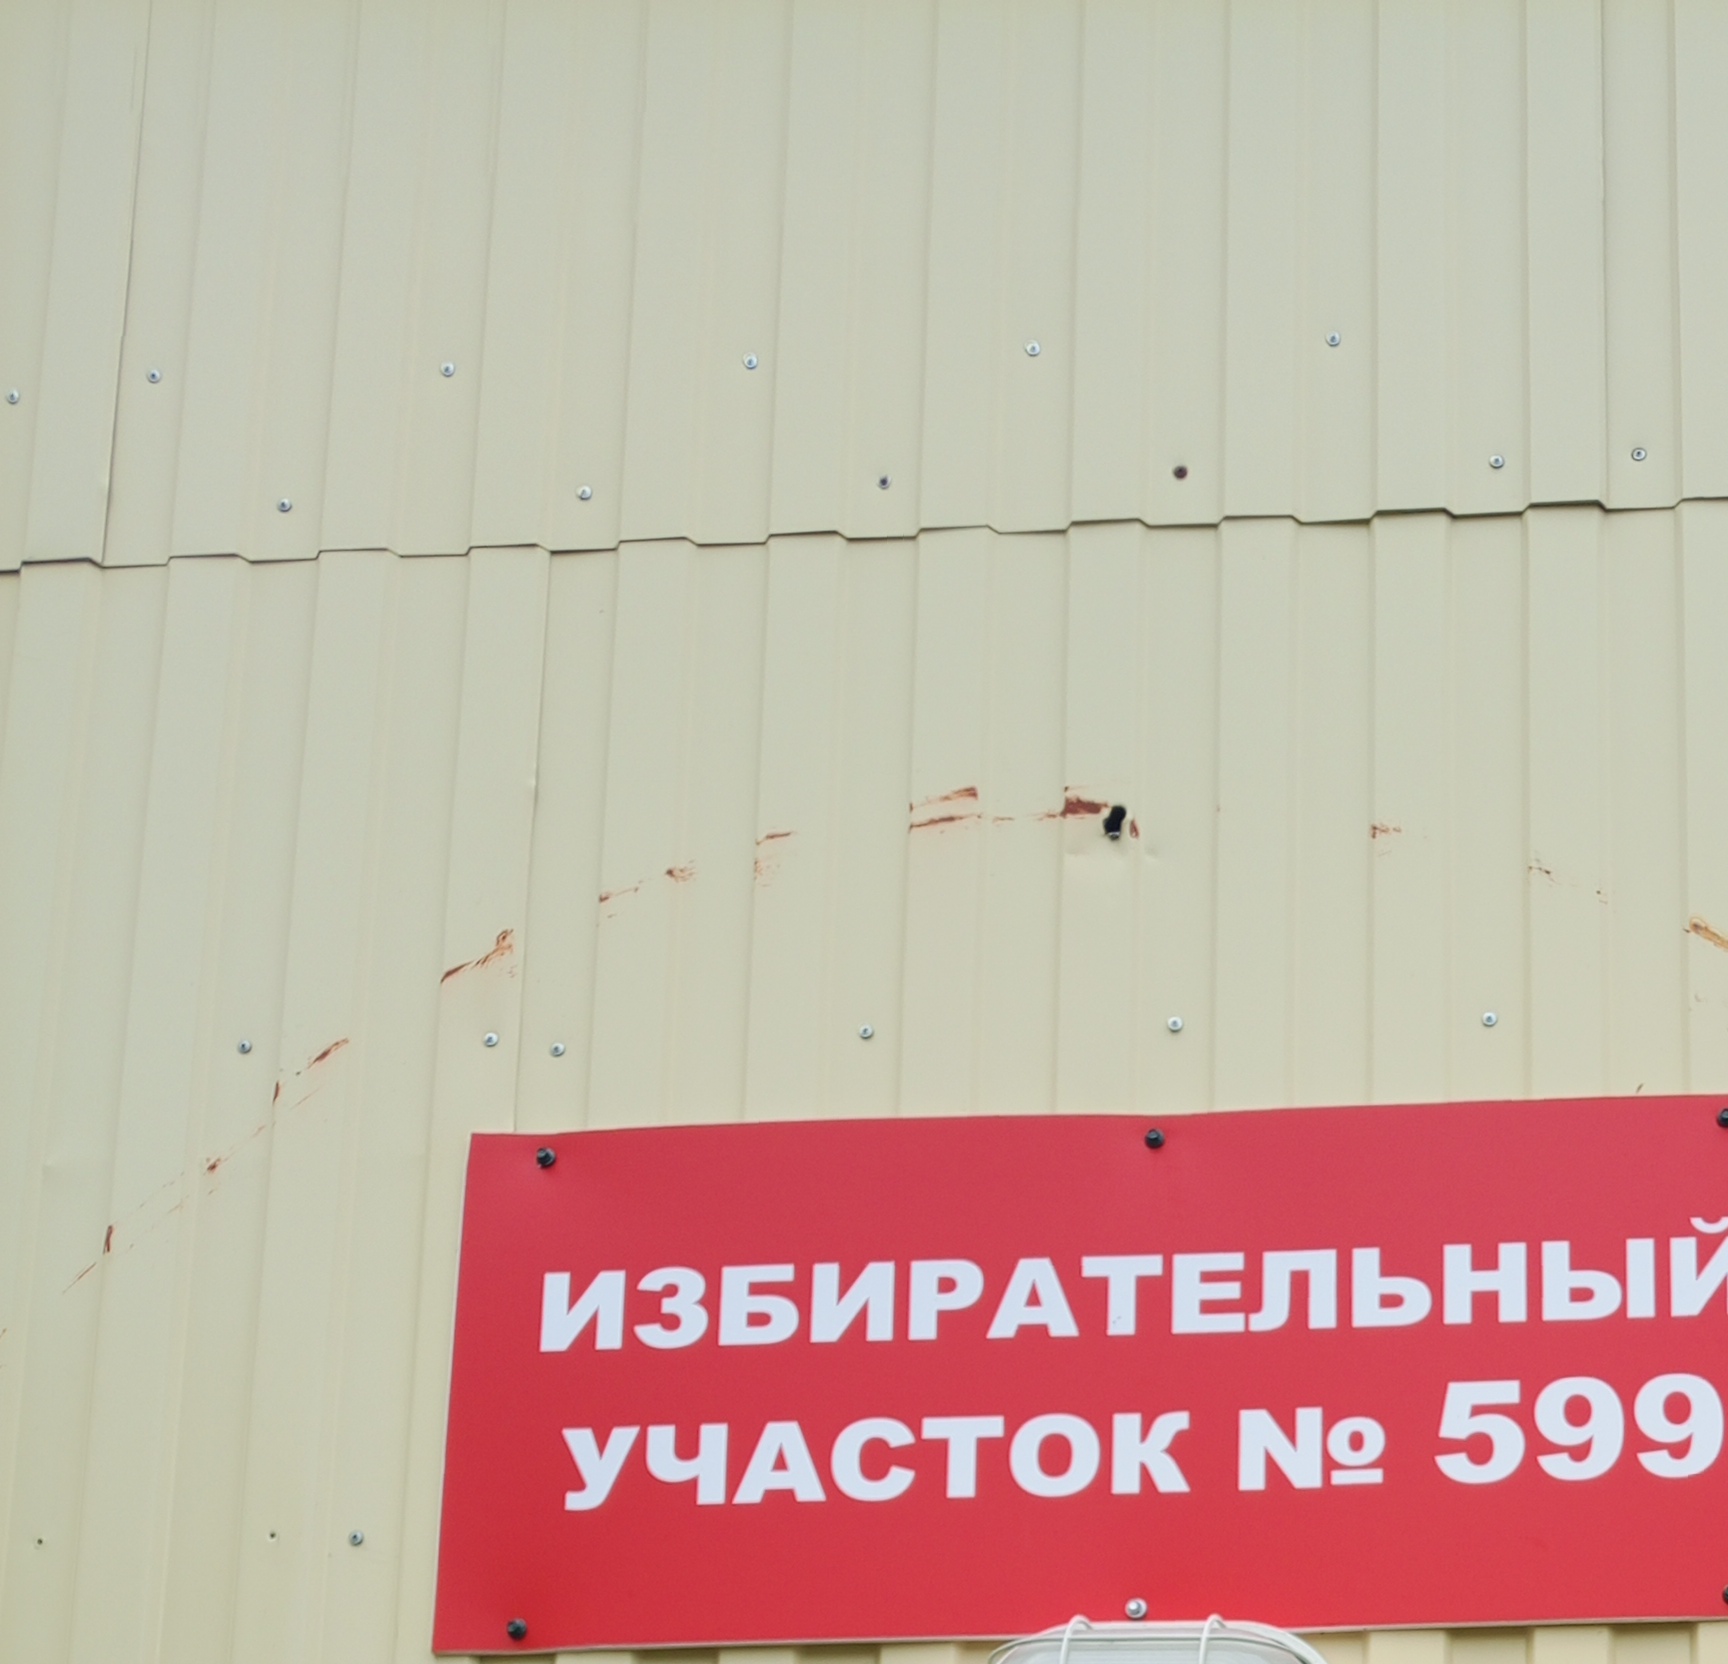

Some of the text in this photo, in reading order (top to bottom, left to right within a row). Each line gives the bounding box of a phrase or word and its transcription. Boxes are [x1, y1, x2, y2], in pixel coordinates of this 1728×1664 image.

[563, 1374, 1724, 1510] УЧАСТОК № 599
